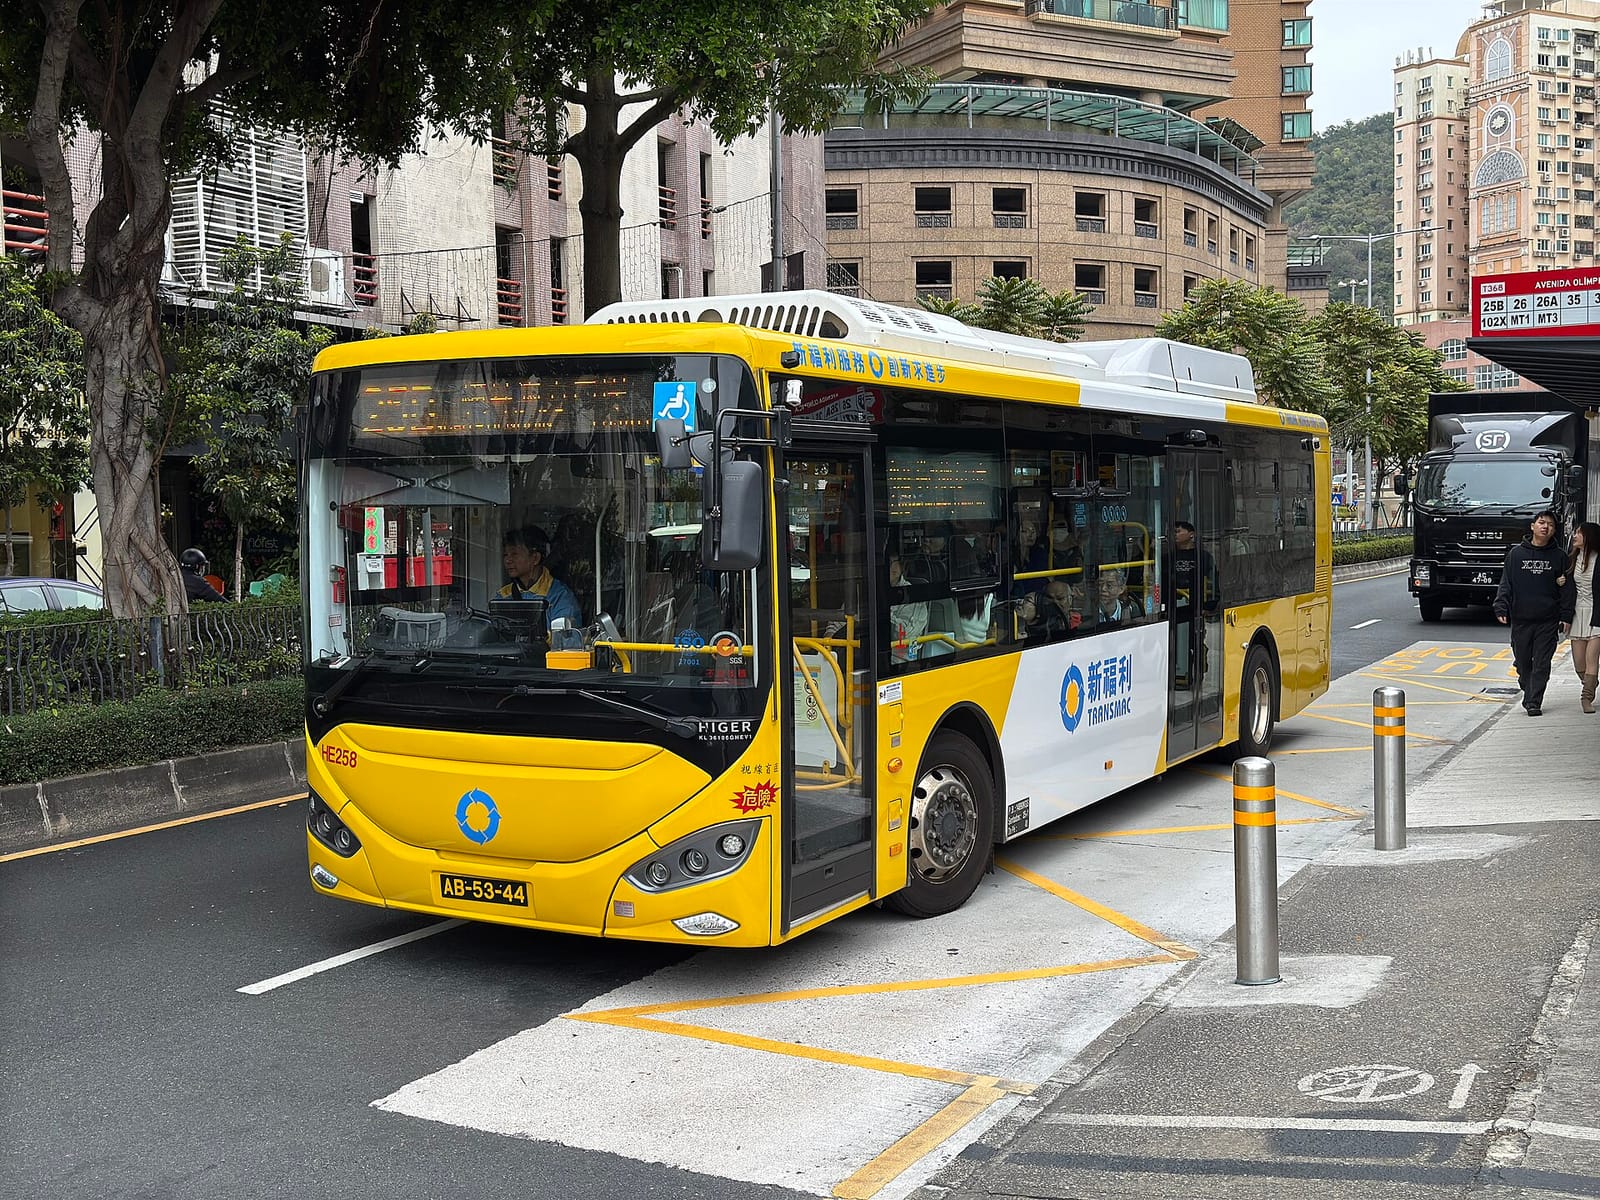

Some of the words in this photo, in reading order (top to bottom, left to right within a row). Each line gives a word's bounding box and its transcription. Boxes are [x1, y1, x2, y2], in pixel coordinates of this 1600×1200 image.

[1482, 284, 1504, 293] T368
[1535, 279, 1571, 289] AVENIDA
[1483, 300, 1504, 312] 25B
[1513, 298, 1527, 310] 26
[1536, 295, 1558, 307] 26A
[1567, 294, 1581, 306] 35
[1481, 317, 1507, 328] 102X
[1511, 314, 1531, 326] MT1
[1538, 313, 1558, 324] MT3
[887, 355, 946, 384] 創新求進步
[1466, 531, 1503, 540] ISUZU
[673, 636, 705, 648] ISO
[1087, 654, 1132, 703] 新福利
[1087, 696, 1132, 727] TRANSMAC
[698, 721, 752, 733] HIGER
[321, 744, 357, 768] HE258
[741, 788, 771, 808] 危險
[443, 877, 525, 904] AB-53-44
